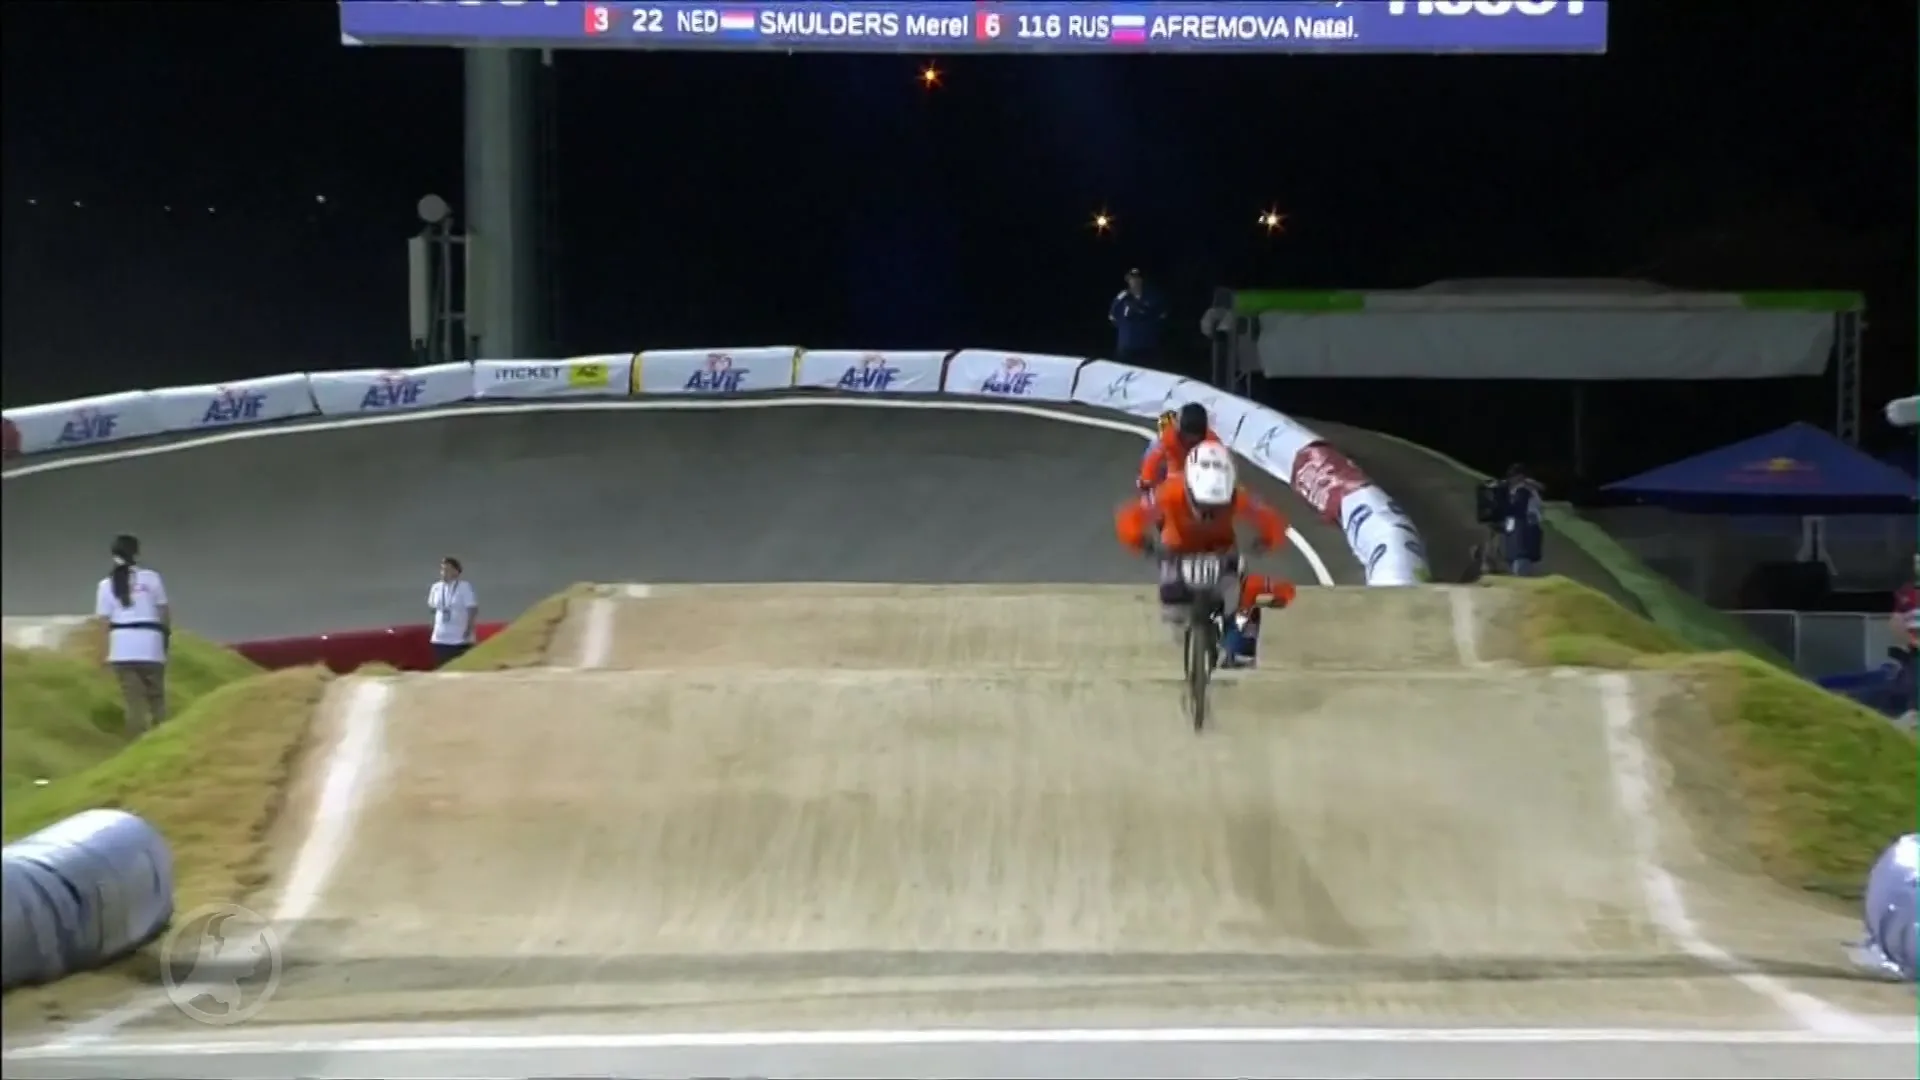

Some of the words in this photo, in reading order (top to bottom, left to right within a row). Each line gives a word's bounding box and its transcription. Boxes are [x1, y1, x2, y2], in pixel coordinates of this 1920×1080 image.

[594, 7, 609, 32] 3
[632, 9, 664, 32] 22
[676, 10, 719, 33] NED
[760, 11, 899, 35] SMULDERS
[906, 15, 968, 36] Merel
[984, 13, 1001, 37] 6
[1017, 15, 1061, 38] 116
[1068, 15, 1110, 38] RUS
[1150, 15, 1290, 39] AFREMOVA
[1294, 16, 1359, 39] Natal.
